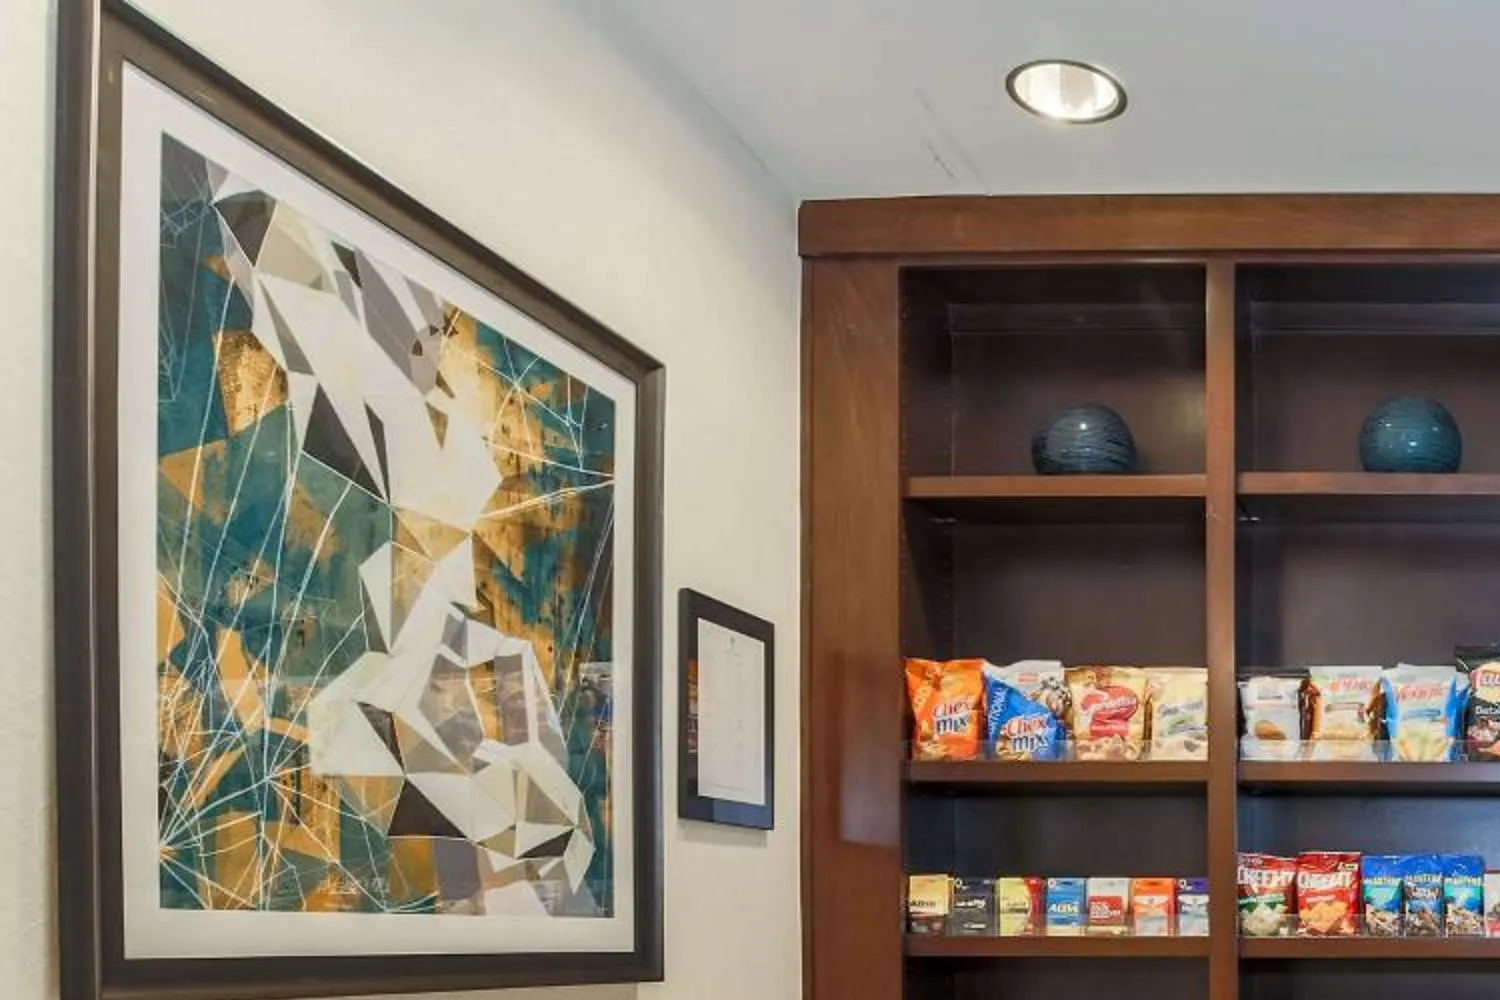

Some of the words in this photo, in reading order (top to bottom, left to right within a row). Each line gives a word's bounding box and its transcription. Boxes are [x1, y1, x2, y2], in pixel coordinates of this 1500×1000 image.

[936, 717, 968, 736] mix
[1007, 717, 1047, 737] Chex
[1013, 734, 1048, 751] mix
